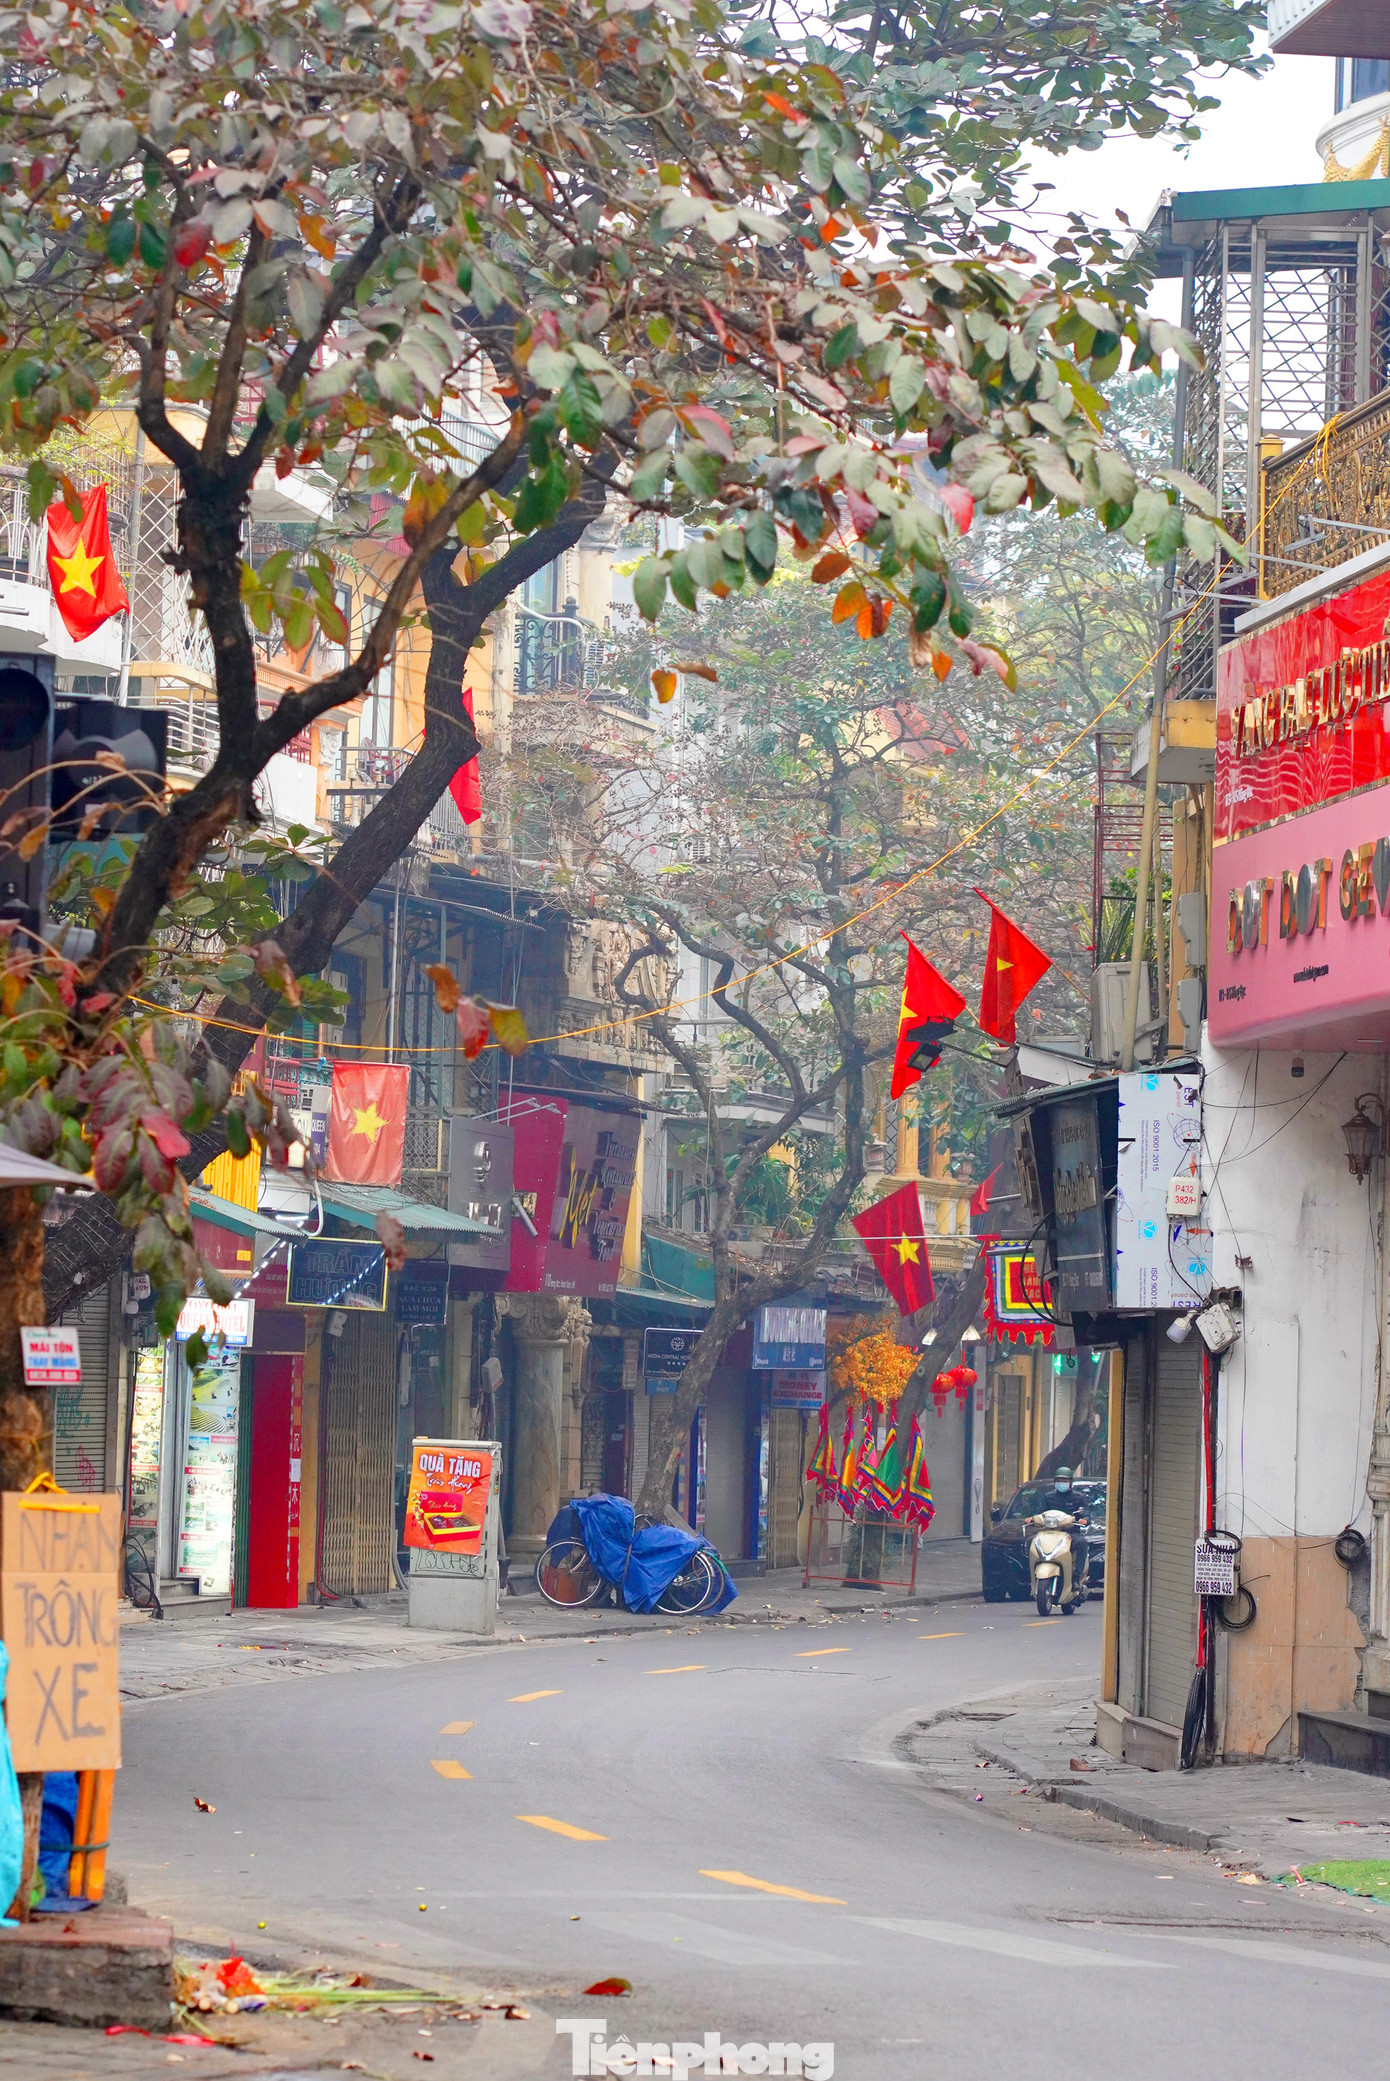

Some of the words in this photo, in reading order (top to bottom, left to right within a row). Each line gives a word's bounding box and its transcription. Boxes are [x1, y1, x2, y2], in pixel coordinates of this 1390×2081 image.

[1226, 877, 1274, 955] DOT
[1280, 858, 1333, 939] DOT
[1175, 1185, 1194, 1193] P432
[180, 1312, 211, 1329] QUEEN
[215, 1315, 245, 1332] HOTEL
[778, 1381, 817, 1390] MONEY
[773, 1390, 822, 1398] EXCHANGE
[419, 1452, 444, 1473] QUÀ
[1211, 1554, 1221, 1563] 959
[1223, 1555, 1232, 1563] 432
[1196, 1581, 1209, 1592] 0966
[1210, 1581, 1221, 1593] 959
[1222, 1582, 1232, 1593] 432
[33, 1663, 105, 1746] XE
